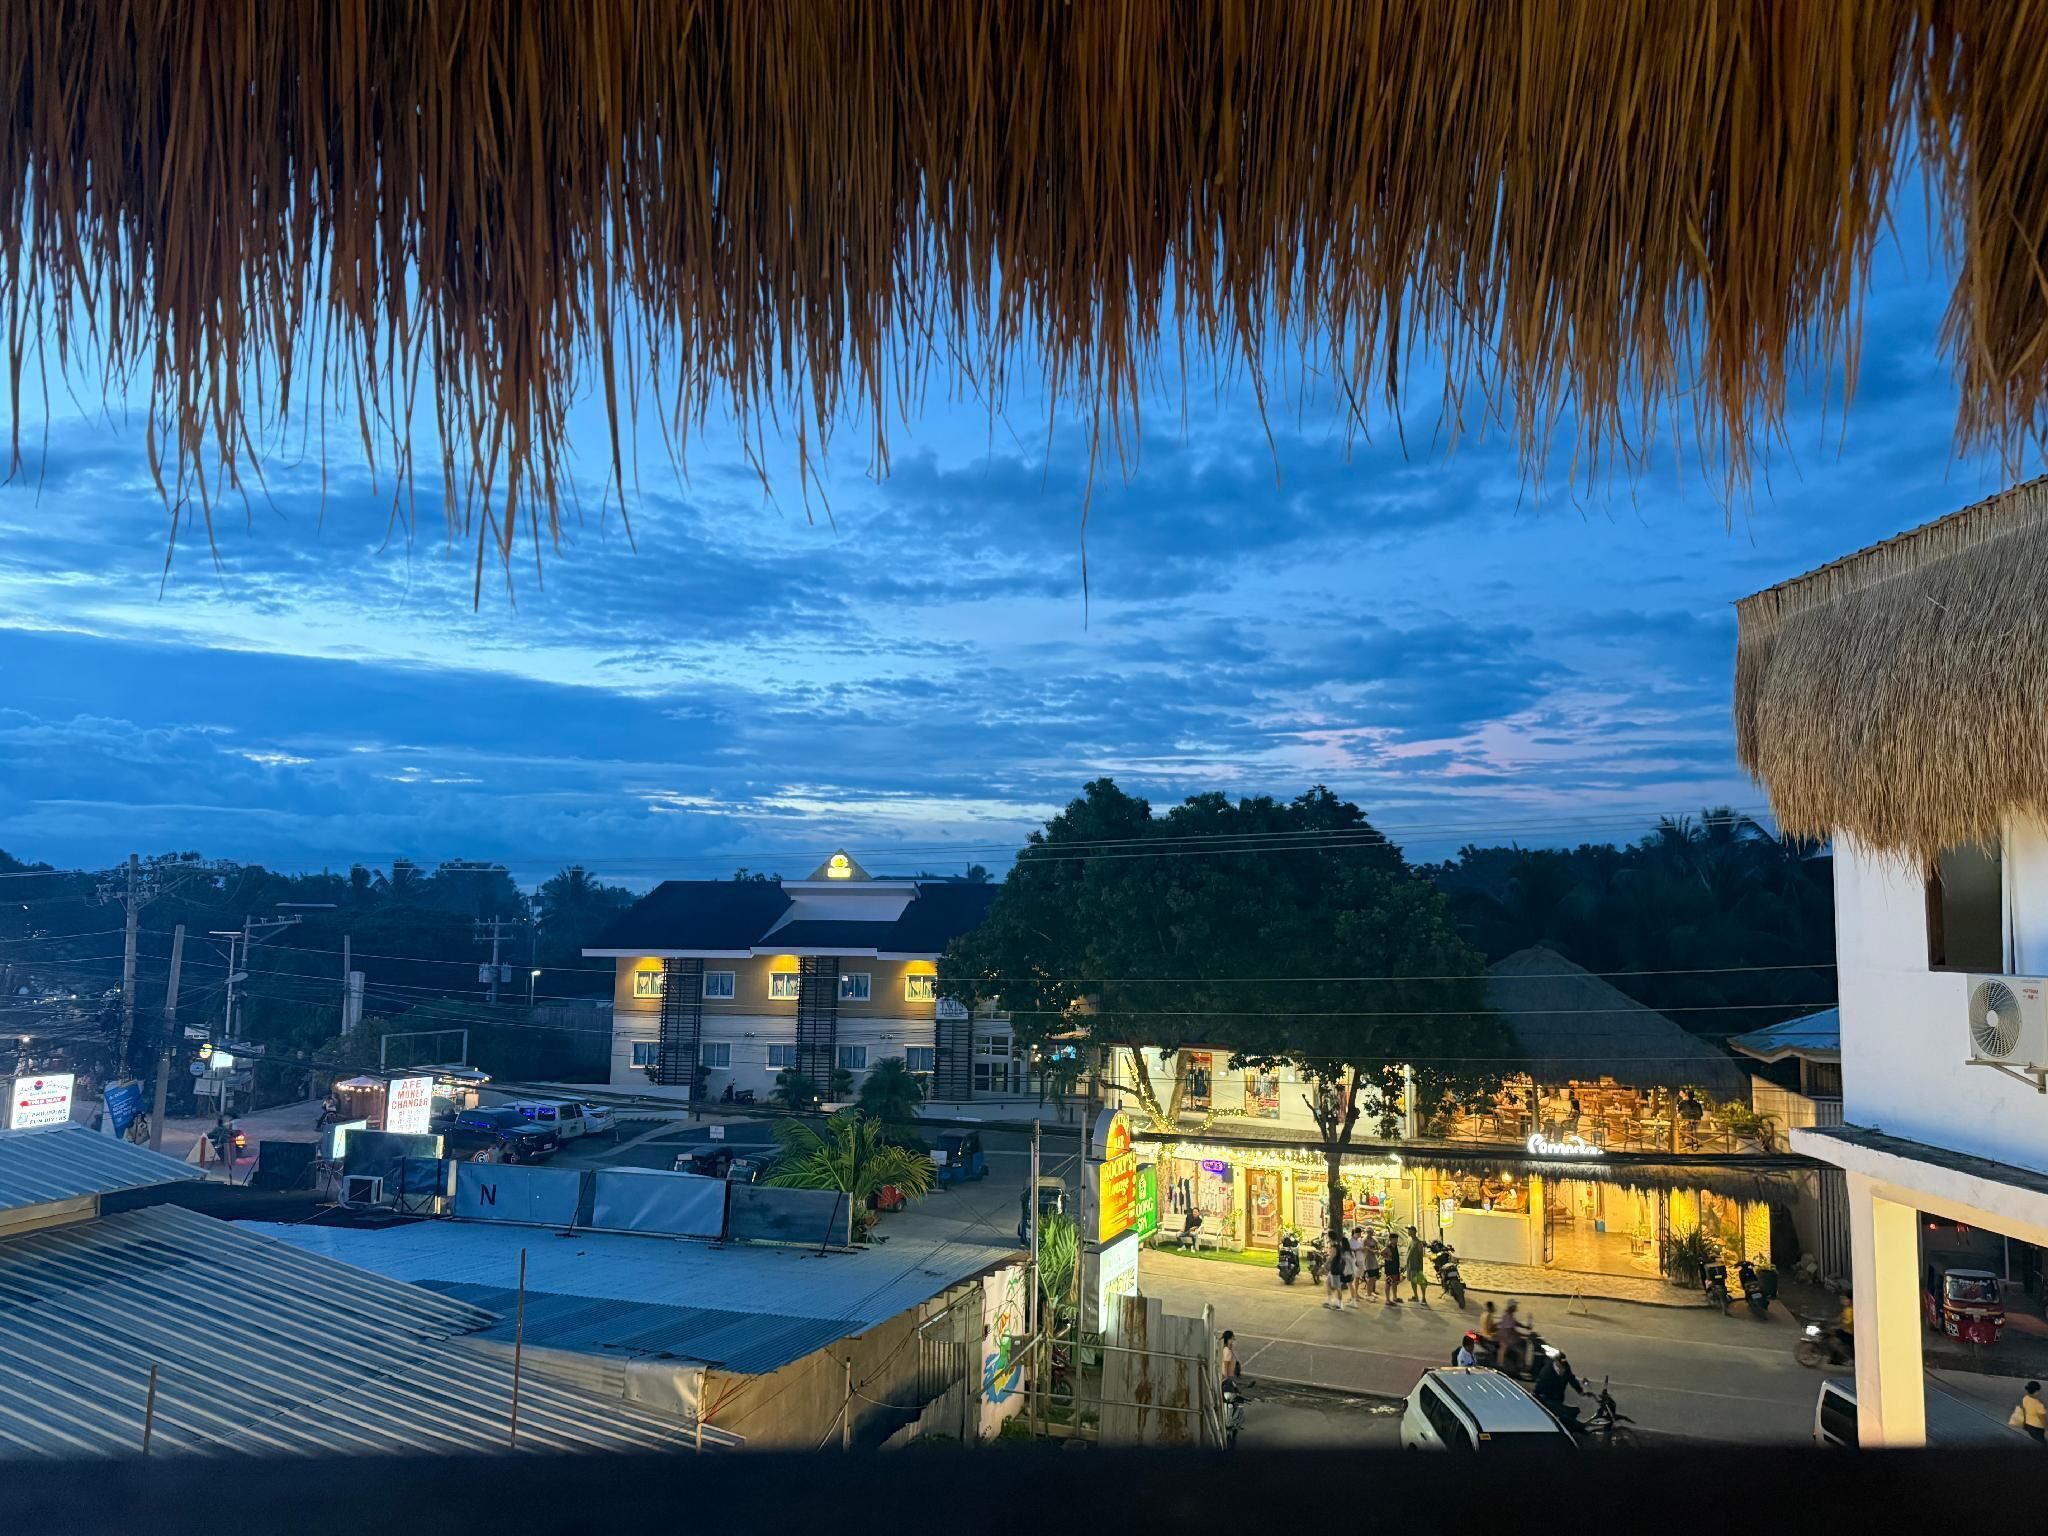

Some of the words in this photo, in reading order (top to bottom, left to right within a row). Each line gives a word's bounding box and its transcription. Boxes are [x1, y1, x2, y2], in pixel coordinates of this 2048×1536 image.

[397, 1089, 425, 1100] MONEY
[391, 1098, 428, 1110] CHANGER
[1104, 1151, 1133, 1181] ROCKY'S
